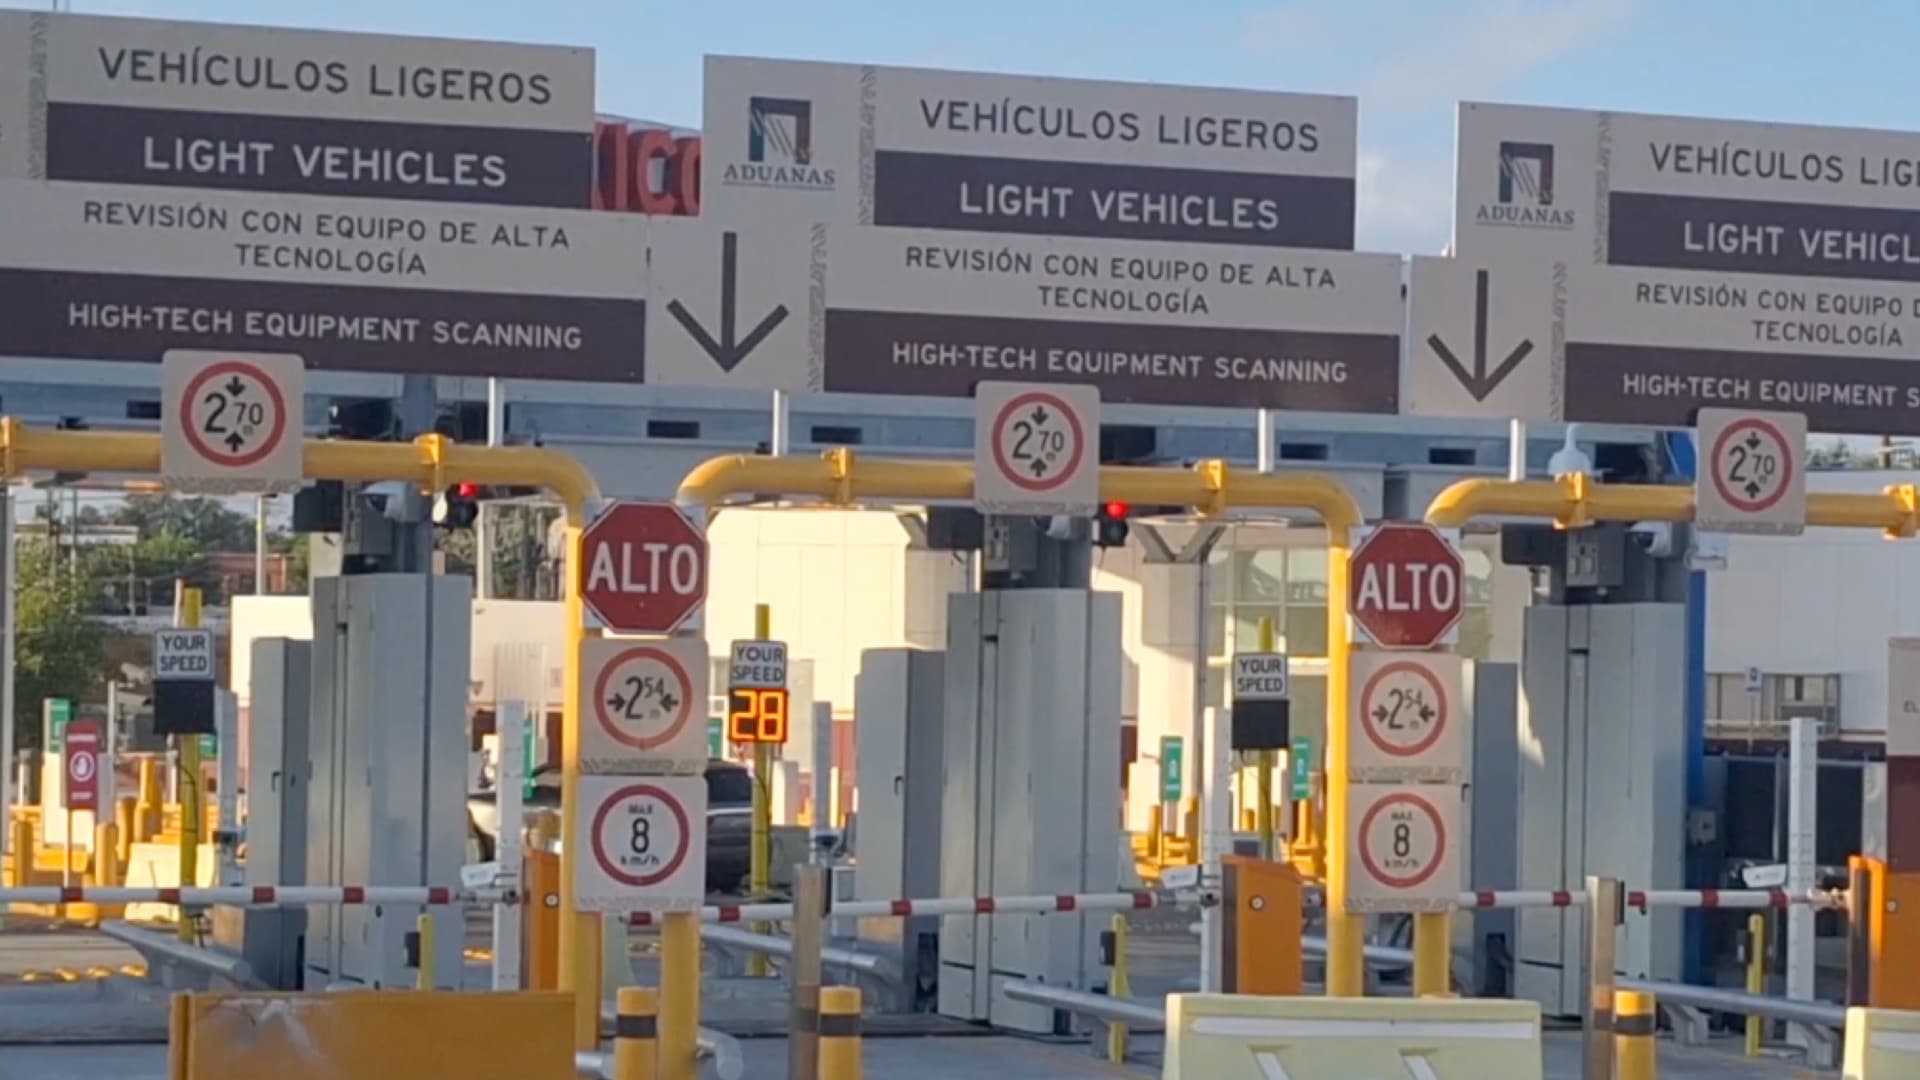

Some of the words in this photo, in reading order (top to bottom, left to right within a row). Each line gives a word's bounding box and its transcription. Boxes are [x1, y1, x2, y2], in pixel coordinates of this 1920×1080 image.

[99, 47, 348, 94] VEHÍCULOS
[370, 64, 550, 104] LIGEROS
[920, 98, 1139, 141] VEHÍCULOS
[1159, 115, 1318, 152] LIGEROS
[145, 137, 273, 174] LIGHT
[293, 145, 506, 186] VEHICLES
[723, 163, 836, 185] ADUANAS
[1650, 142, 1843, 183] VEHÍCULOS
[1861, 157, 1920, 187] LIG
[961, 182, 1073, 218] LIGHT
[1091, 191, 1278, 229] VEHICLES
[1476, 204, 1575, 225] ADUANAS
[84, 201, 226, 229] REVISIÓN
[242, 210, 301, 234] CON
[316, 214, 426, 241] EQUIPO
[440, 221, 476, 244] DE
[492, 225, 568, 248] ALTA
[1685, 222, 1784, 254] LIGHT
[235, 244, 426, 275] TECNOLOGÍA
[906, 246, 1031, 273] REVISIÓN
[1044, 255, 1098, 277] CON
[1111, 258, 1208, 282] EQUIPO
[1221, 264, 1253, 285] DE
[1266, 266, 1334, 287] ALTA
[1038, 286, 1208, 314] TECNOLOGÍA
[1637, 283, 1746, 307] REVISIÓN
[1757, 289, 1806, 312] CON
[1817, 294, 1902, 317] EQUIPO
[70, 304, 232, 333] HIGH-TECH
[246, 312, 419, 341] EQUIPMENT
[434, 321, 581, 349] SCANNING
[1752, 320, 1902, 346] TECNOLOGÍA
[894, 342, 1036, 369] HIGH-TECH
[1048, 350, 1202, 376] EQUIPMENT
[1216, 358, 1347, 382] SCANNING
[1624, 374, 1749, 399] HIGH-TECH
[1760, 380, 1896, 405] EQUIPMENT
[587, 541, 699, 597] ALTO
[1357, 563, 1456, 612] ALTO
[161, 635, 207, 650] YOUR
[735, 646, 783, 662] YOUR
[160, 655, 208, 671] SPEED
[733, 665, 783, 682] SPEED
[1239, 658, 1282, 673] YOUR
[1237, 677, 1283, 693] SPEED
[731, 690, 785, 740] 28
[631, 817, 650, 853] 8
[1393, 823, 1410, 857] 8
